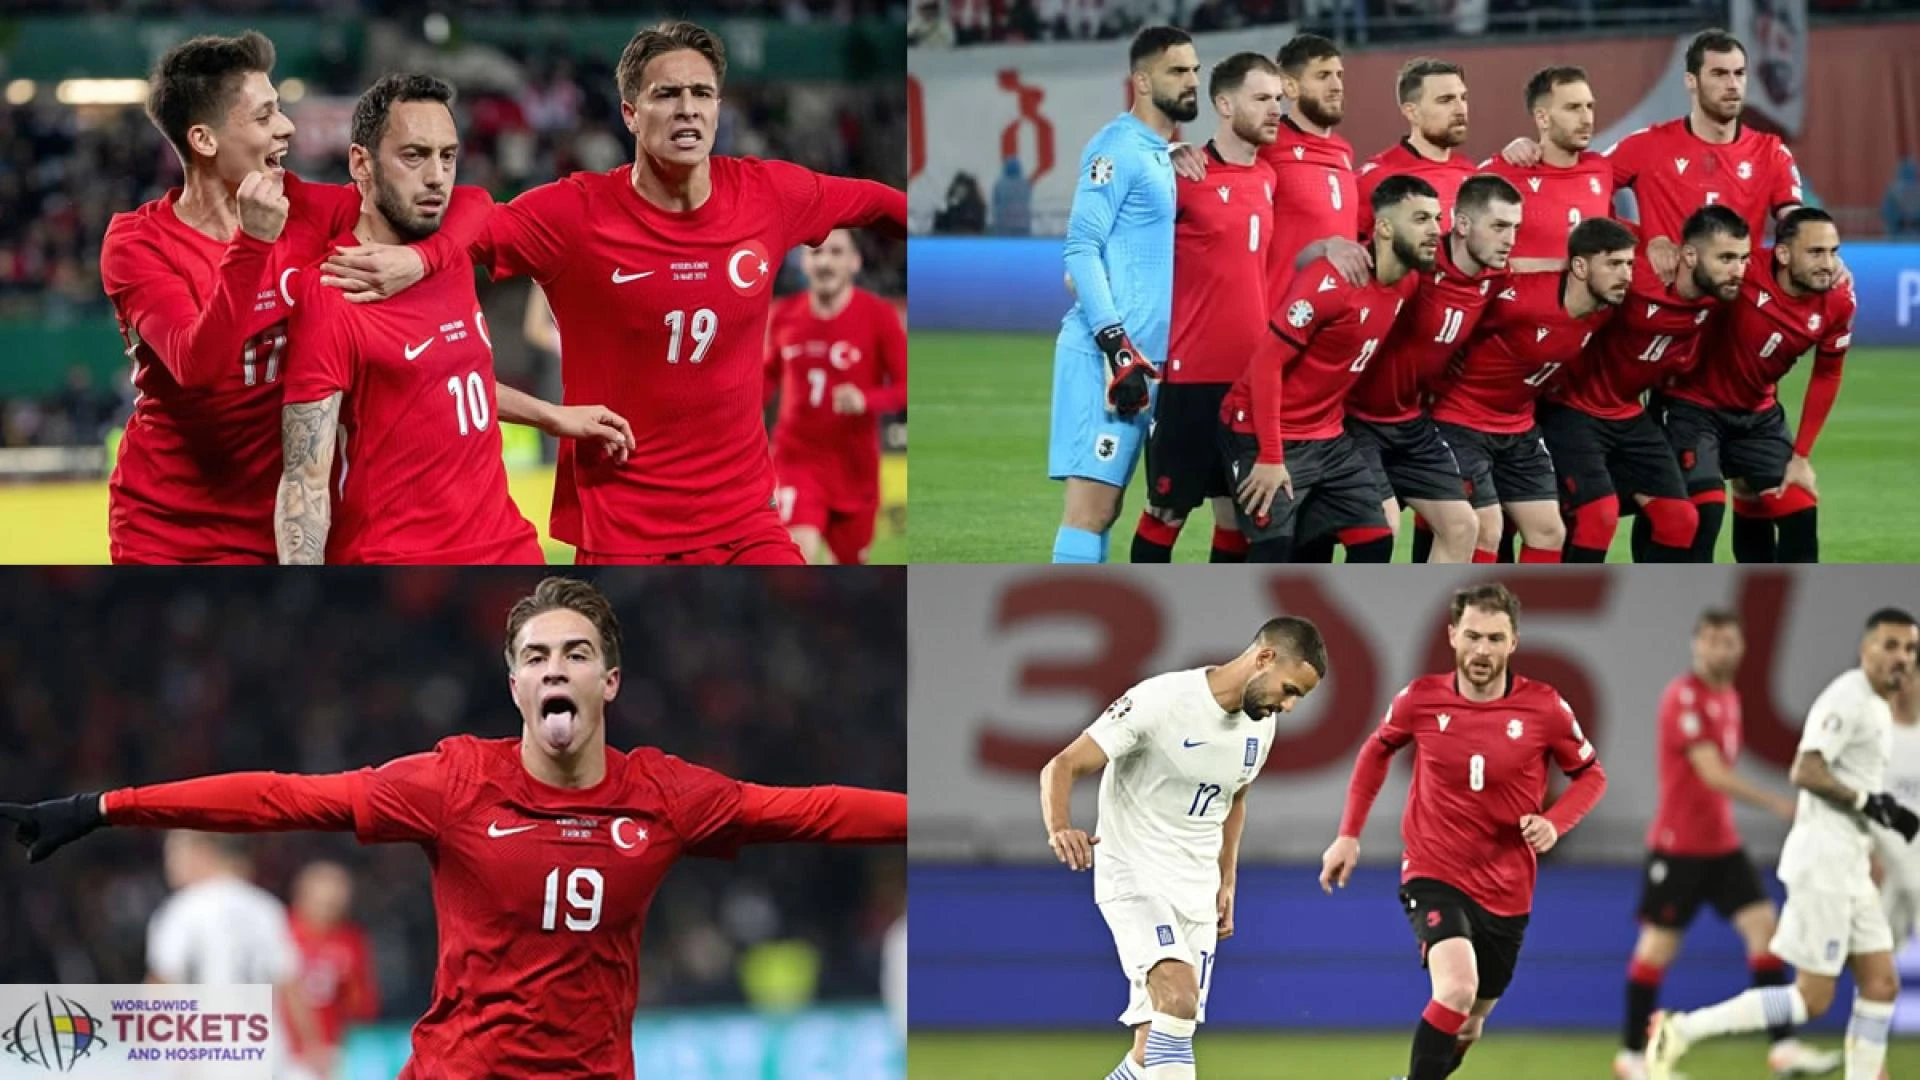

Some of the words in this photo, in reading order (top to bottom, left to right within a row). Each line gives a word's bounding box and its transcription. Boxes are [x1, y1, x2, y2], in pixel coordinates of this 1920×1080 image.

[244, 335, 287, 387] 17
[663, 308, 718, 364] 19
[447, 370, 489, 436] 10
[541, 866, 604, 932] 19
